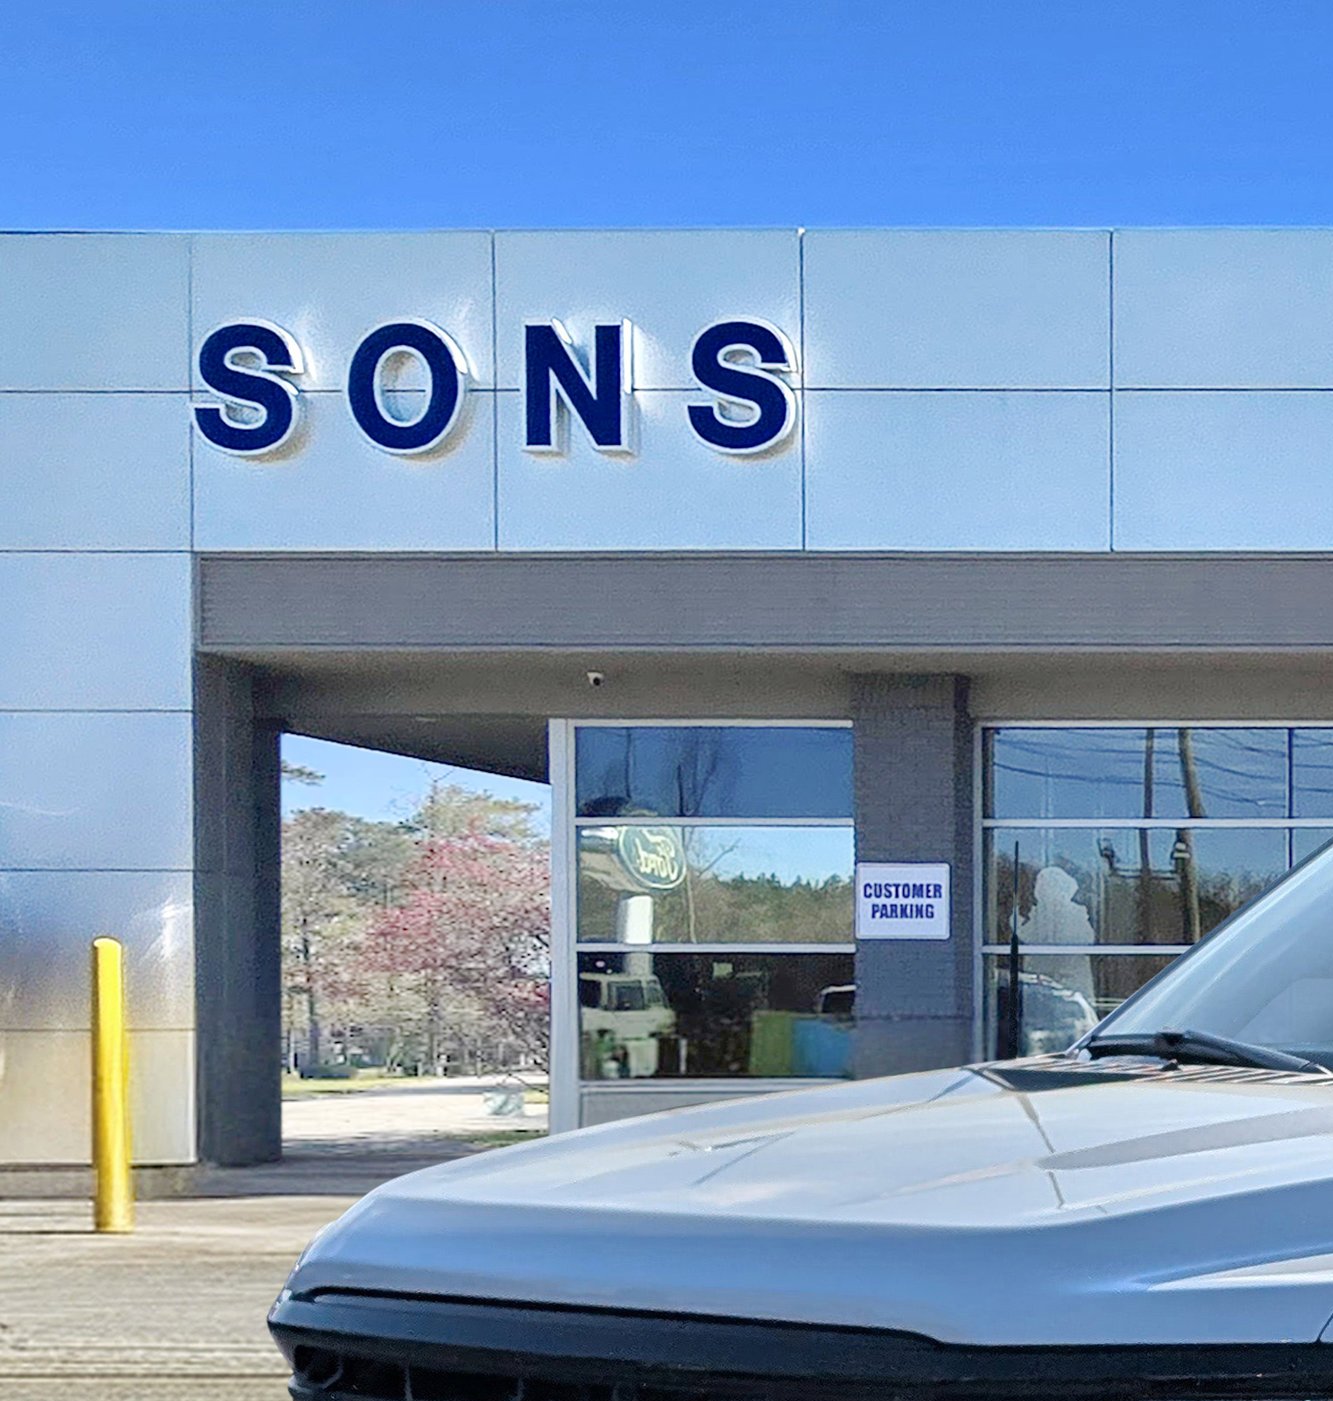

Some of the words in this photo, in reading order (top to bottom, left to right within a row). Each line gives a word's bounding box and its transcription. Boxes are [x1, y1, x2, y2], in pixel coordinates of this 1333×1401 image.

[194, 320, 798, 453] SONS
[864, 883, 942, 898] CUSTOMER
[872, 904, 934, 918] PARKING
